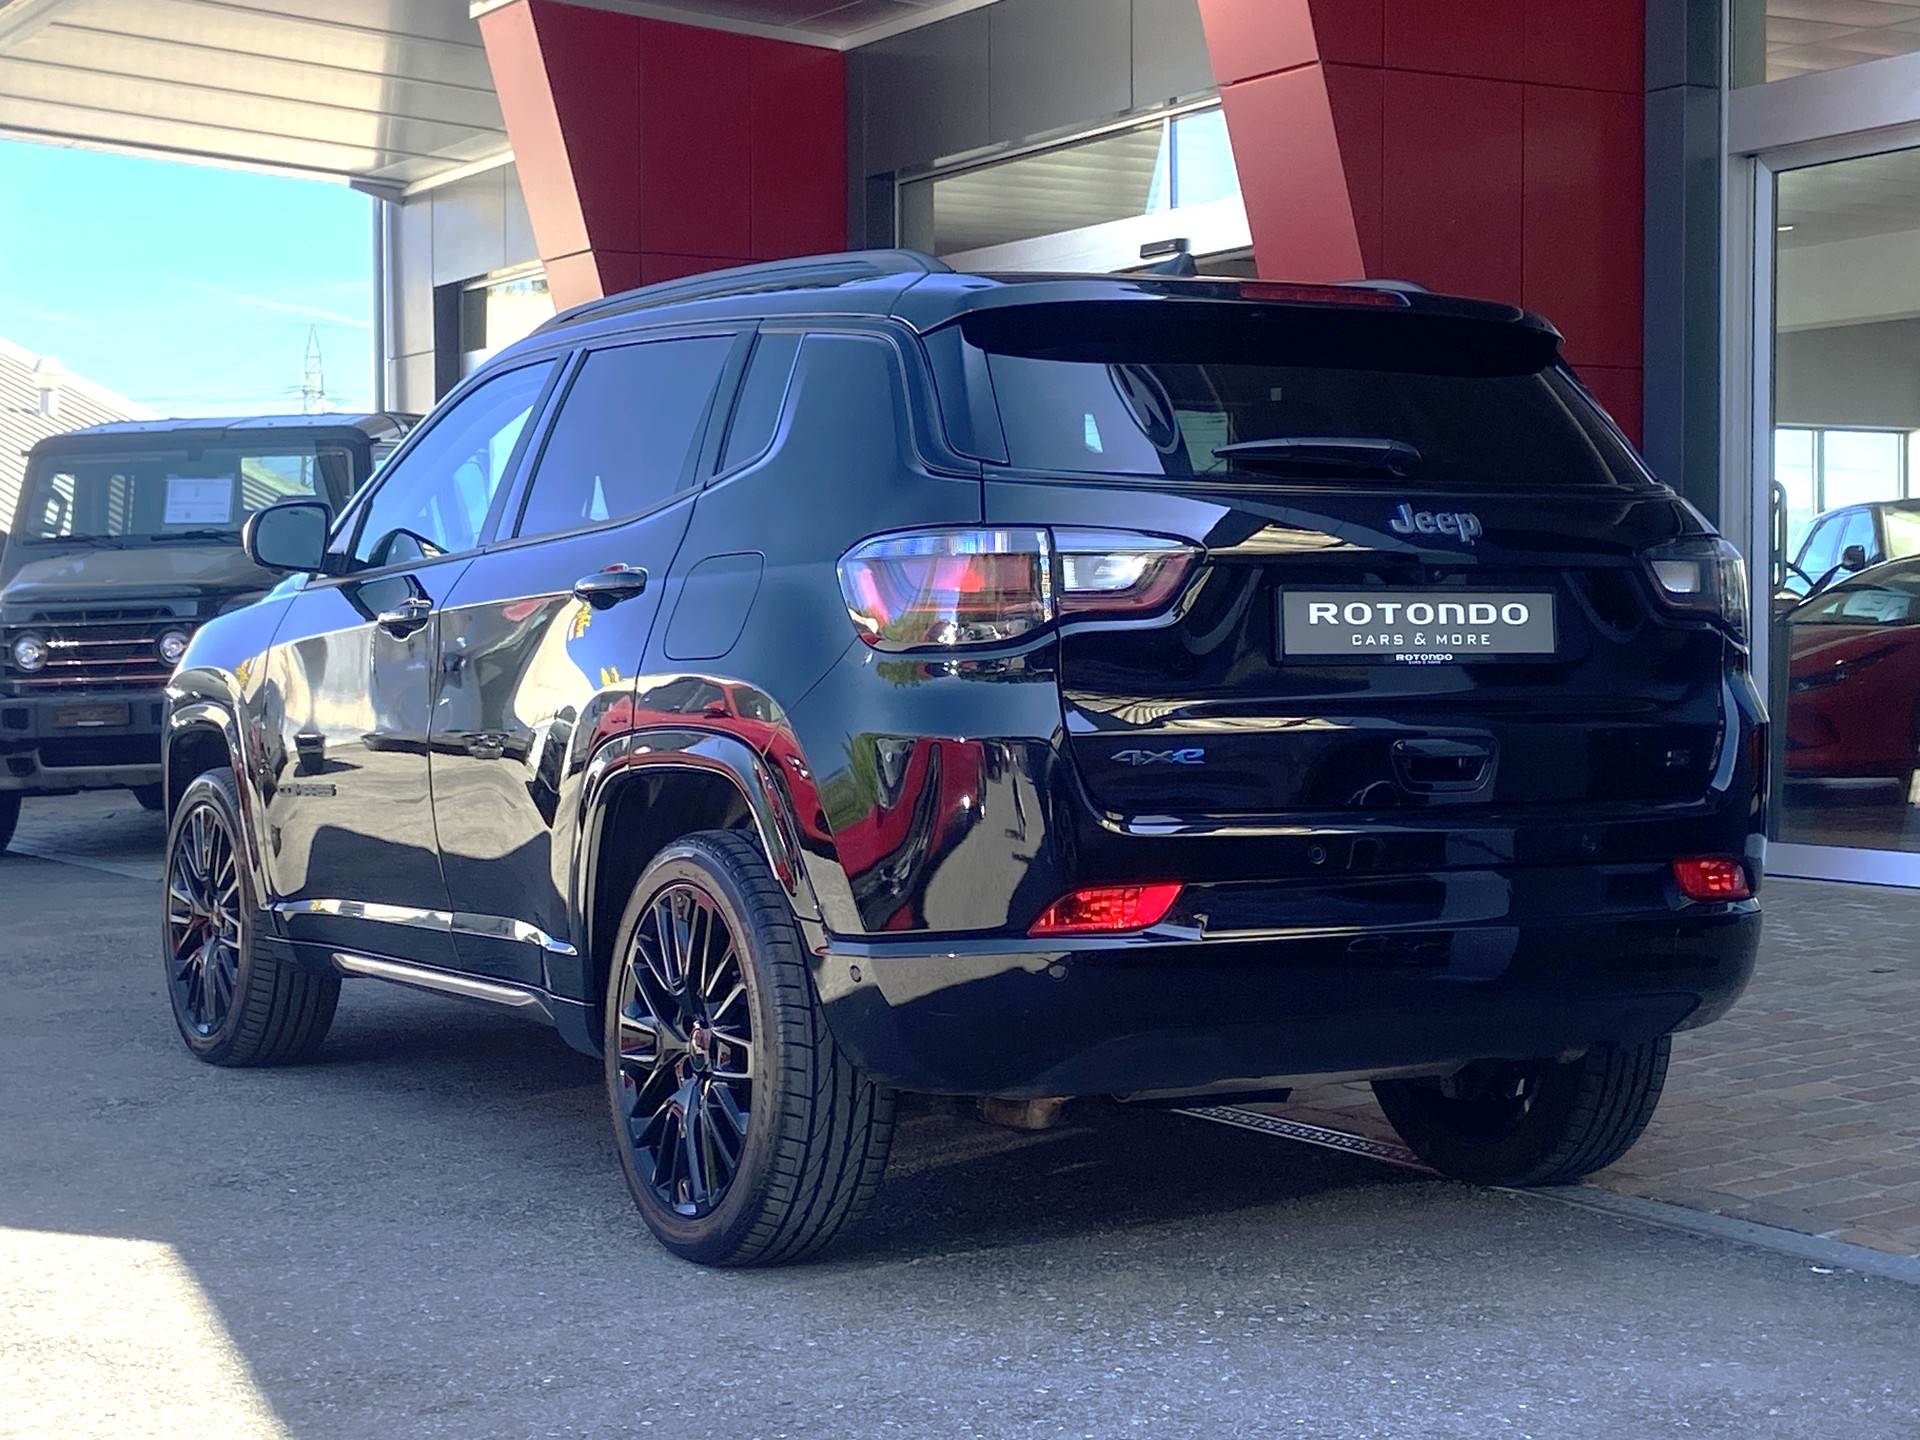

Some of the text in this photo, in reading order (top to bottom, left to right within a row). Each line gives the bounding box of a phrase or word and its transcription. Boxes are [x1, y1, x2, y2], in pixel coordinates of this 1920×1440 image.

[1389, 503, 1483, 543] Jeep
[1308, 602, 1530, 625] ROTONDO
[1351, 632, 1491, 646] CARS & MORE
[1395, 653, 1453, 661] ROTONDO
